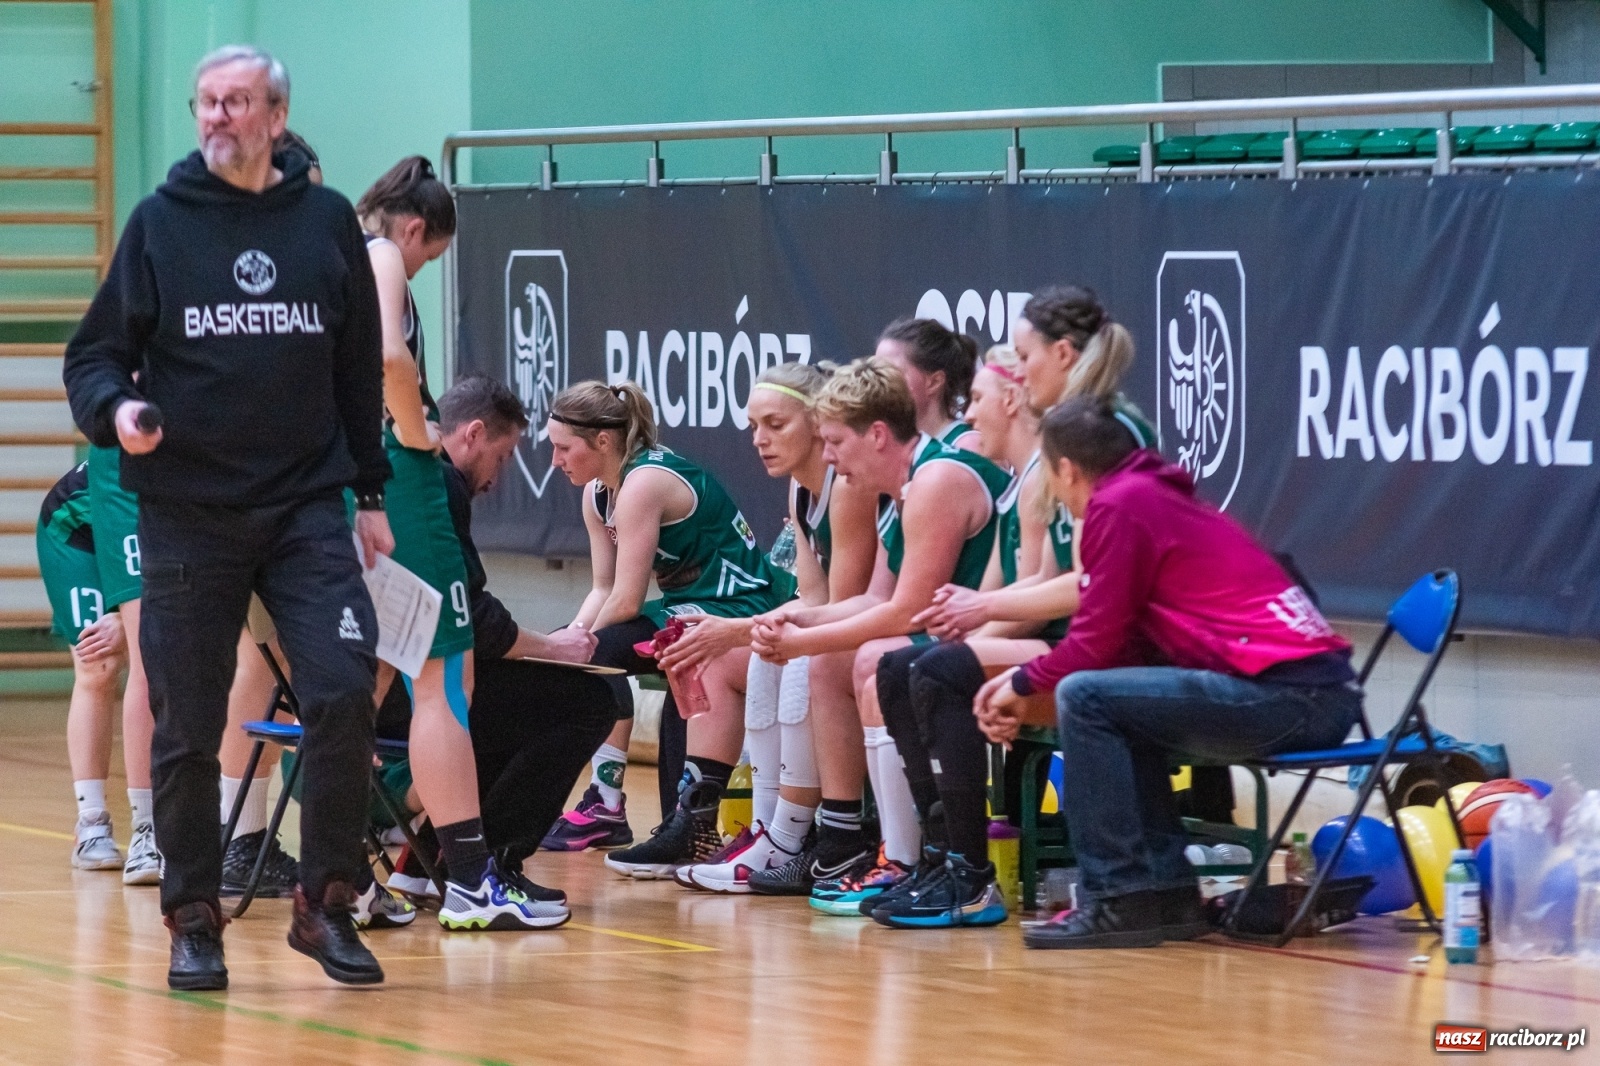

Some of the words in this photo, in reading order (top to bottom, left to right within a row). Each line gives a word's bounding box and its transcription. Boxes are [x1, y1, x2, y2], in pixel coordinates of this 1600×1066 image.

[184, 302, 324, 338] BASKETBALL
[1297, 301, 1593, 467] RACIBÓRZ
[123, 534, 142, 576] 8
[70, 586, 104, 628] 13
[450, 580, 470, 628] 9
